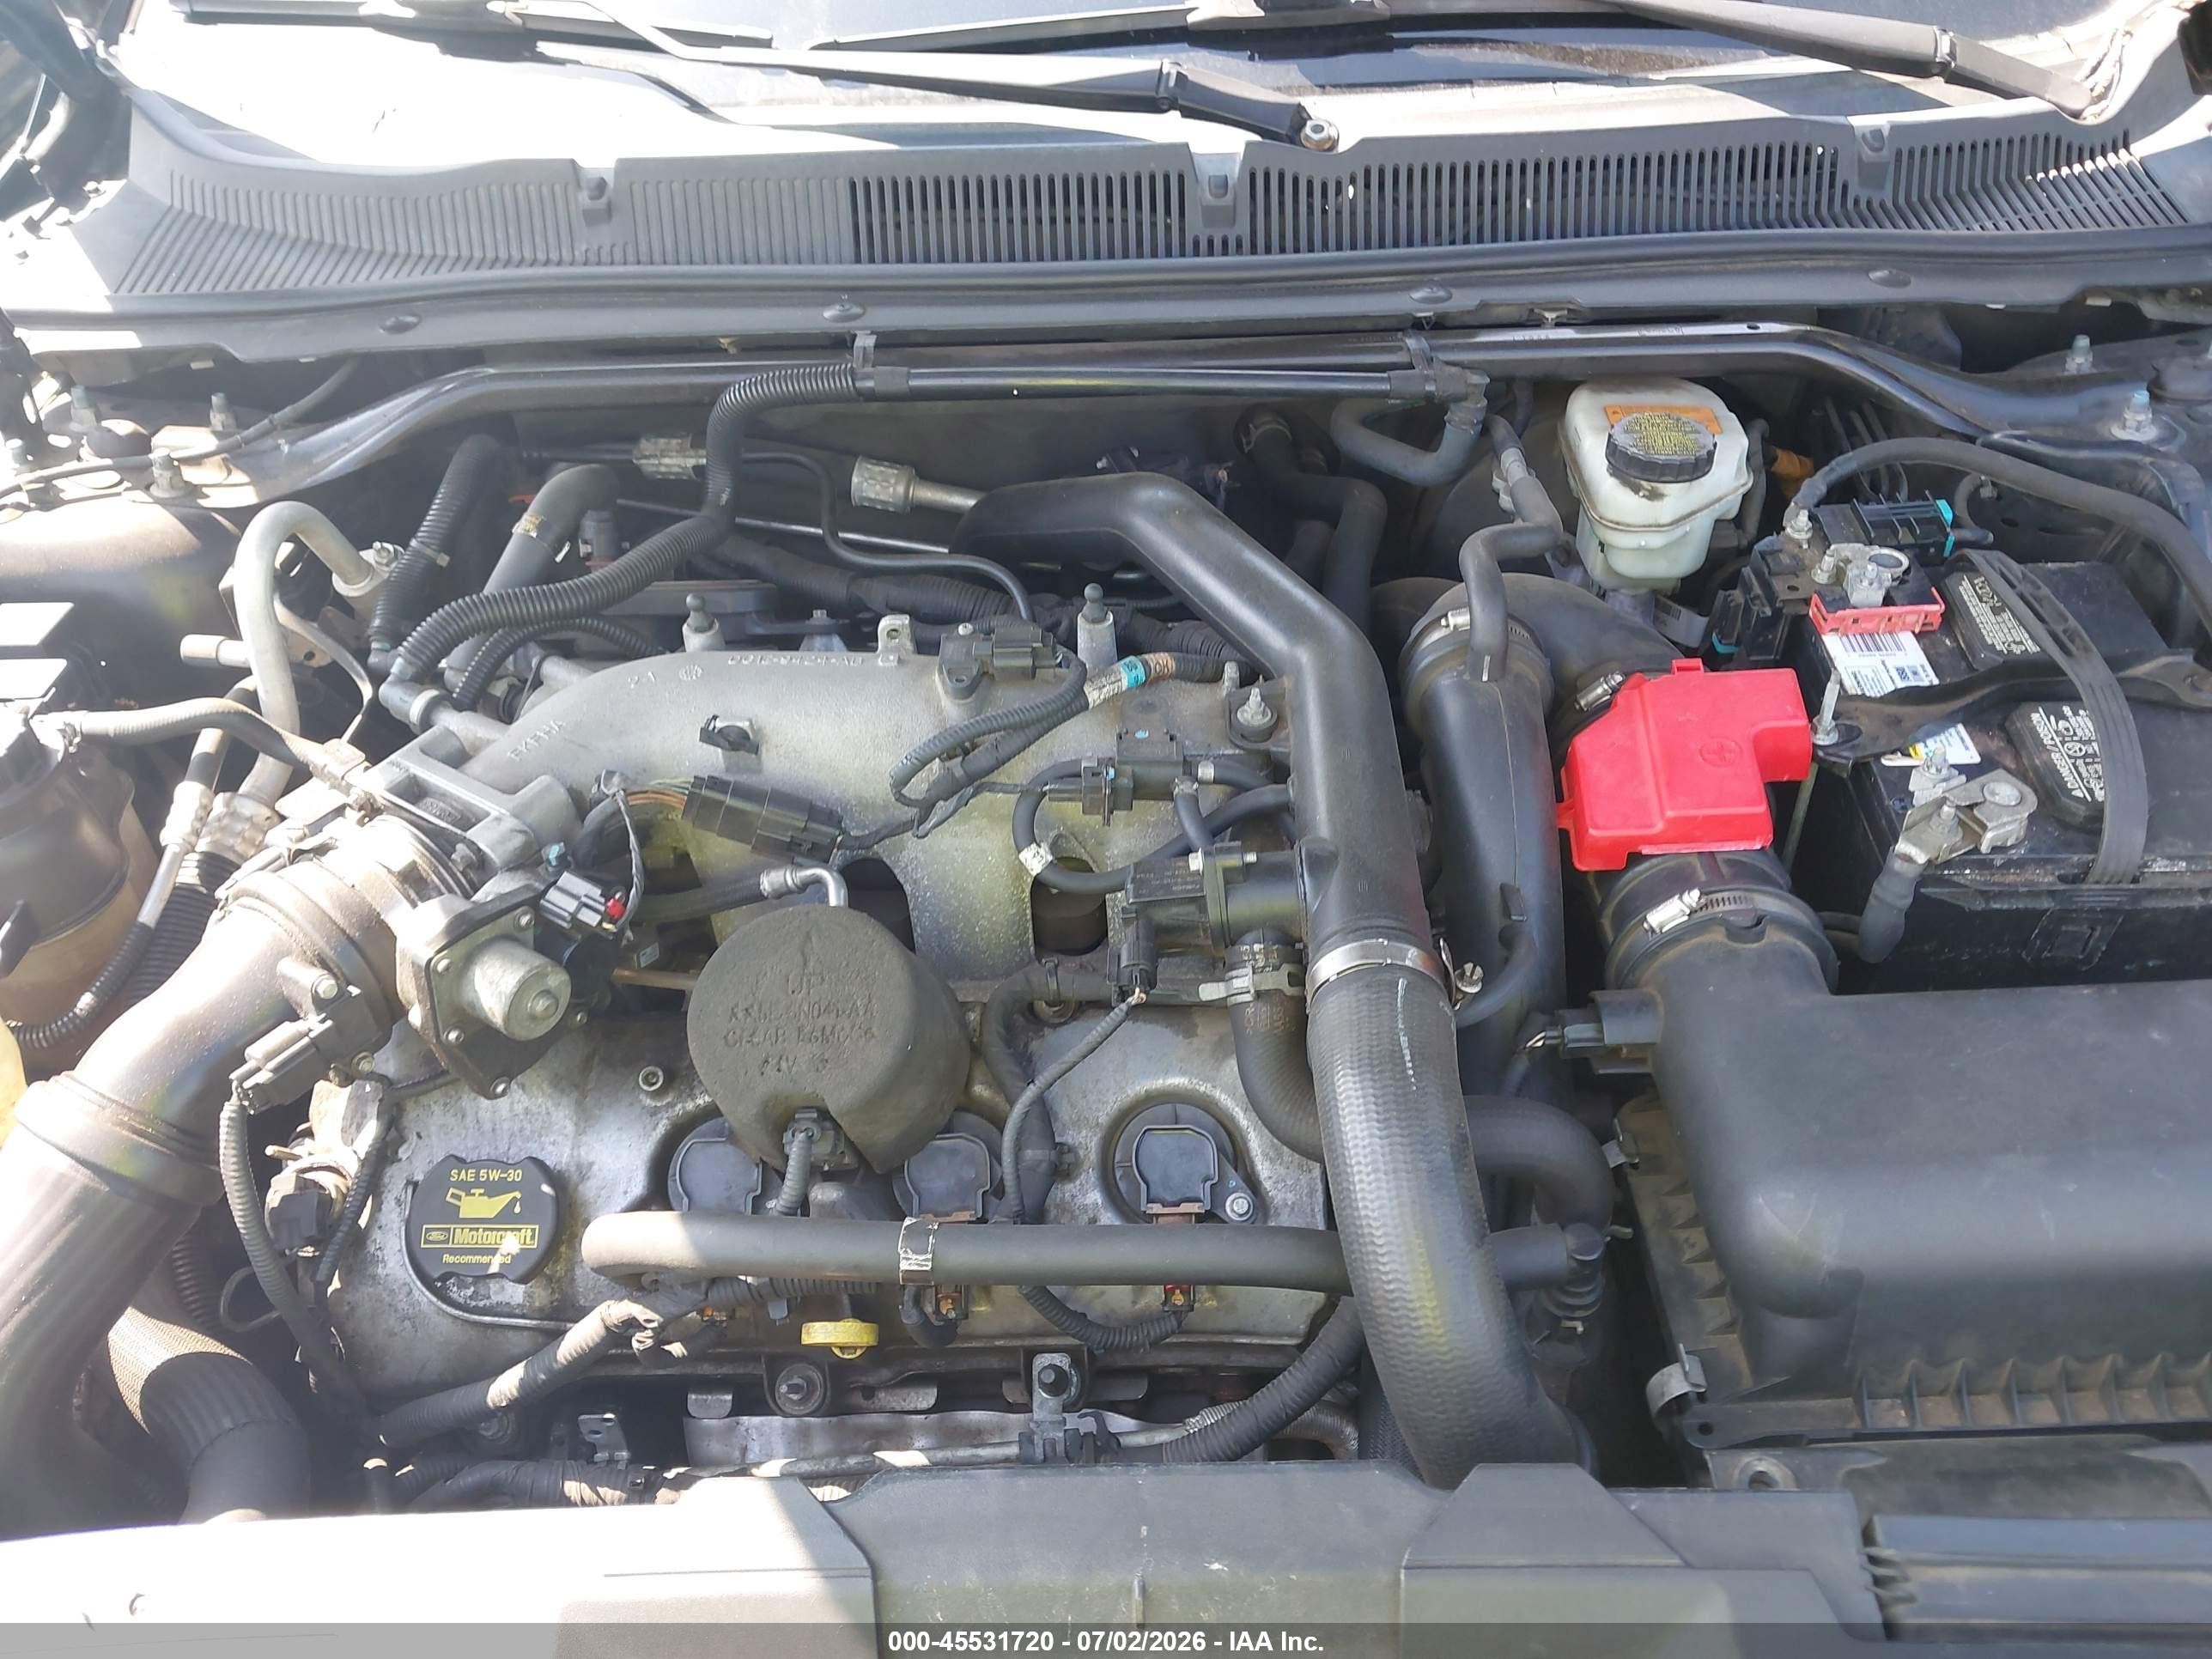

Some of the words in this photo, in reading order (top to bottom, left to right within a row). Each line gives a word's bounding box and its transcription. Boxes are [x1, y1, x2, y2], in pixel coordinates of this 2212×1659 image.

[2030, 712, 2056, 745] POISON
[2051, 751, 2079, 789] DANGER
[450, 1169, 475, 1182] SAE
[479, 1169, 523, 1182] 5W-30
[442, 1254, 511, 1264] Recommened
